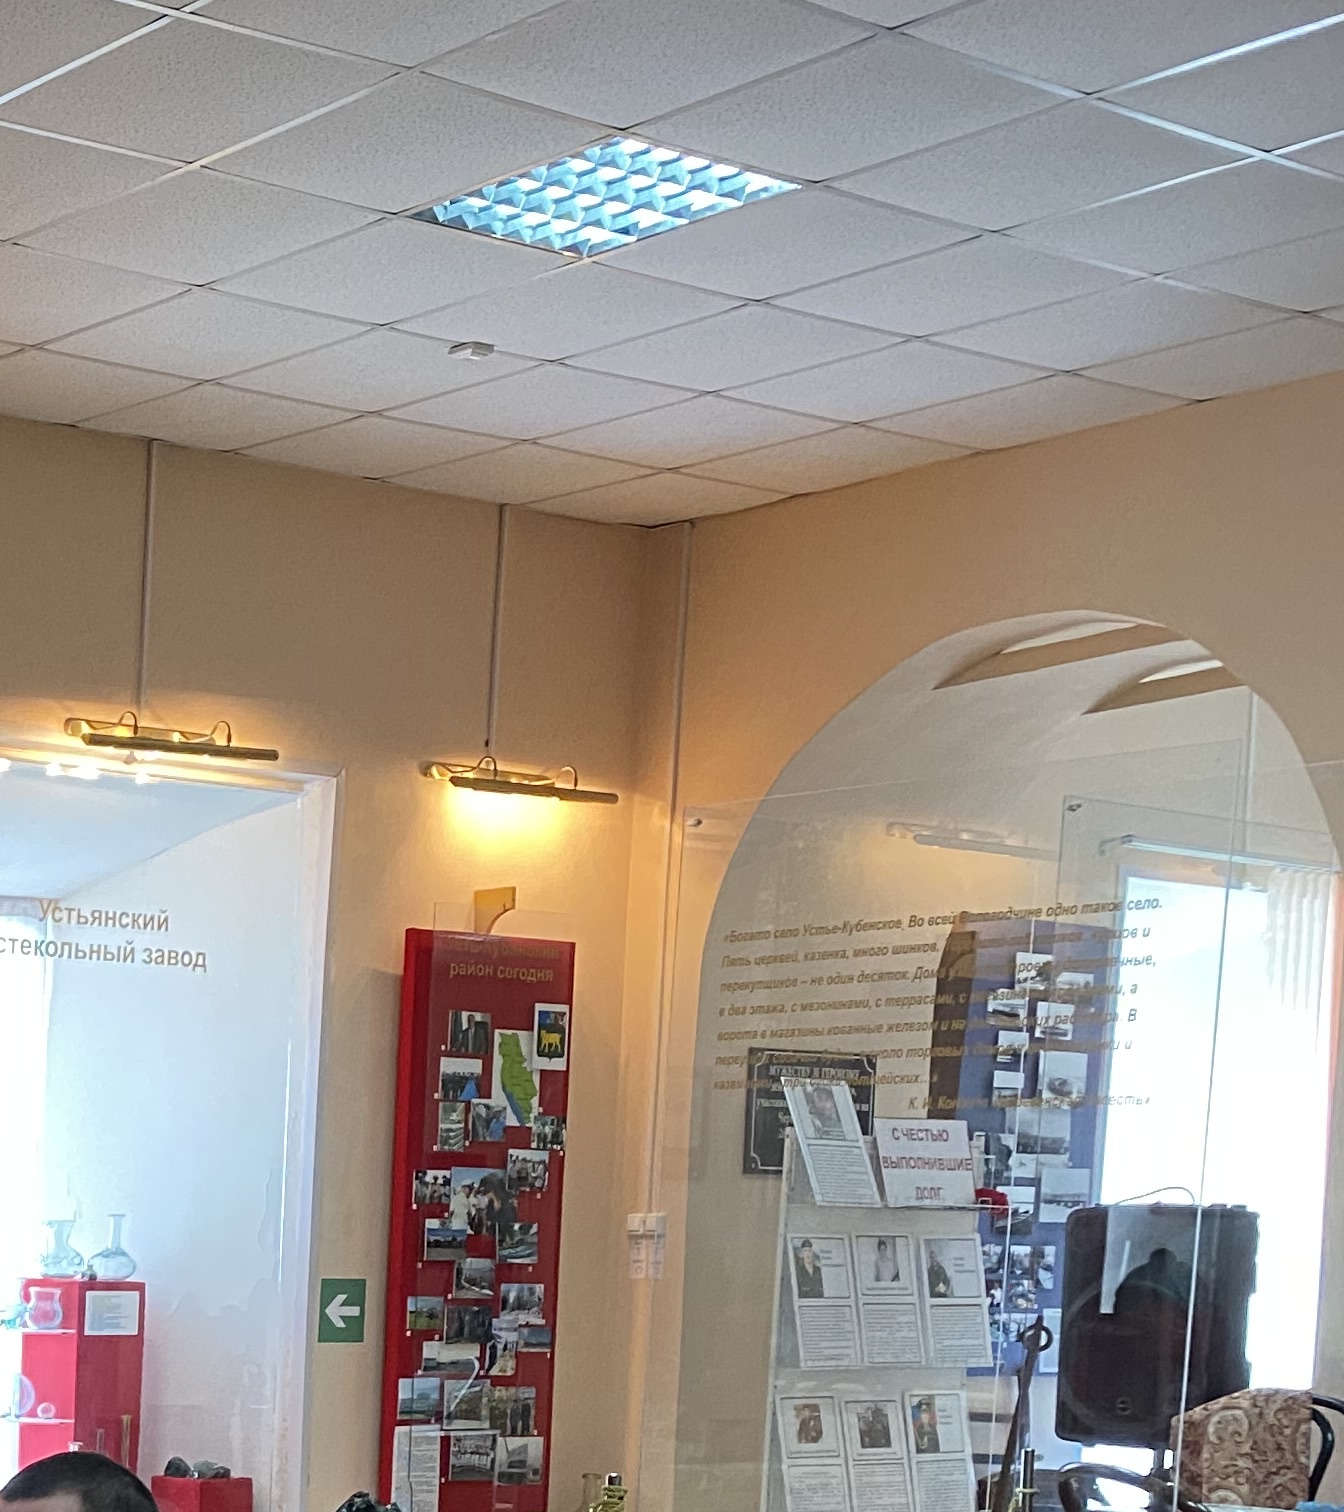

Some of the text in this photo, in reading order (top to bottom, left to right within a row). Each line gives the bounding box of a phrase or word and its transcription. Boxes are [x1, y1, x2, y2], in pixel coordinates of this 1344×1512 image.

[38, 899, 170, 932] Устьянский
[773, 927, 800, 939] село
[908, 914, 925, 928] Во
[928, 909, 955, 926] всей
[1046, 902, 1078, 917] одно
[1080, 899, 1123, 914] такое
[1126, 896, 1163, 911] село.
[721, 954, 751, 968] Пять
[852, 945, 888, 960] много
[1142, 927, 1151, 937] и
[141, 946, 208, 974] завод
[497, 965, 554, 983] сегодня
[810, 976, 824, 987] не
[826, 971, 854, 986] один
[728, 1003, 747, 1017] два
[791, 1003, 797, 1012] с
[875, 998, 882, 1008] с
[717, 1028, 758, 1041] ворота
[769, 1025, 825, 1039] магазины
[1128, 1007, 1138, 1022] В
[892, 1127, 950, 1142] С ЧЕСТЬЮ
[881, 1155, 973, 1171] ВЫПОЛНИВШИЕ
[915, 1186, 944, 1201] ДОЛГ
